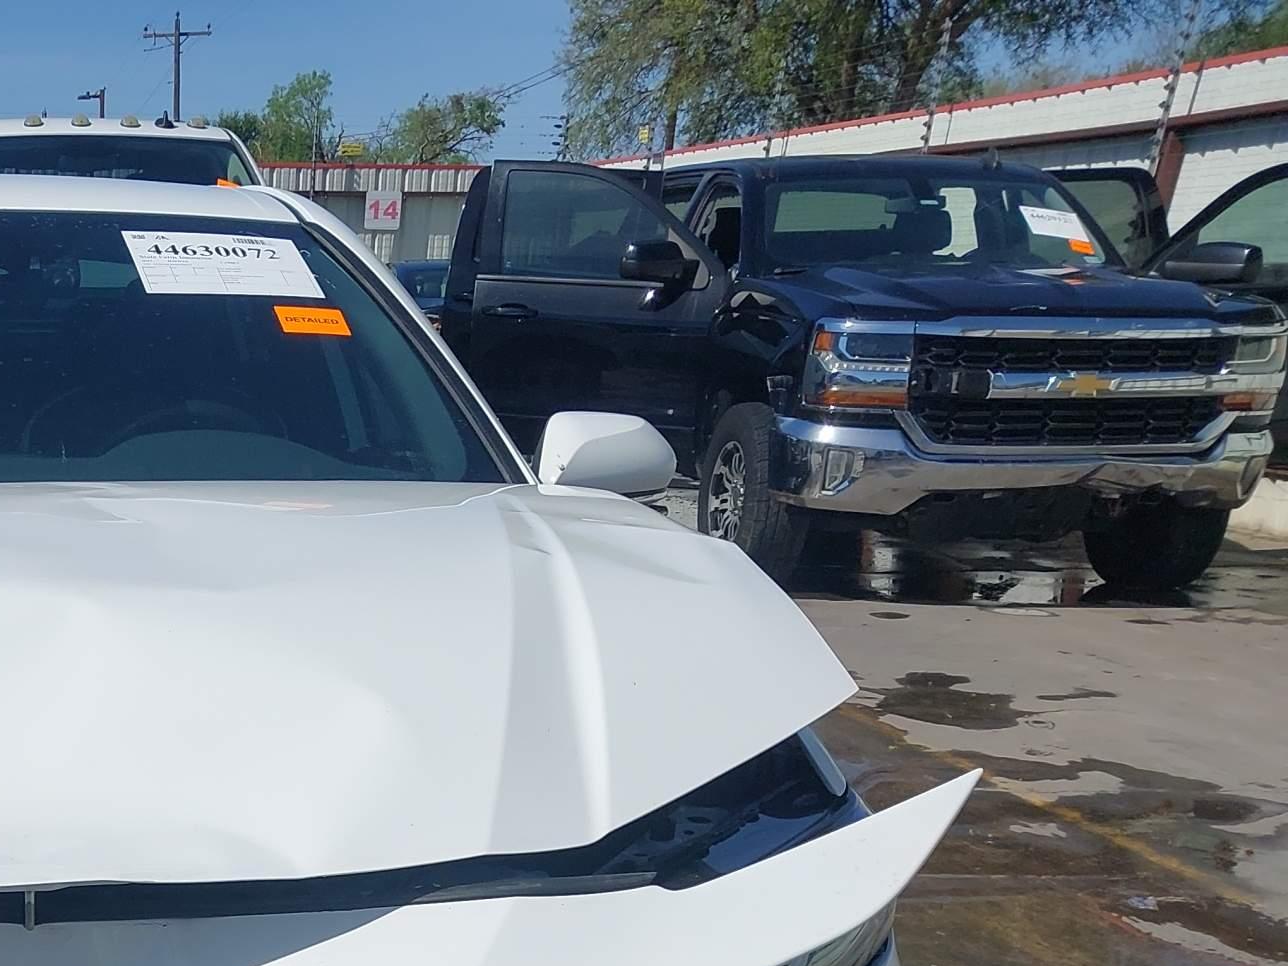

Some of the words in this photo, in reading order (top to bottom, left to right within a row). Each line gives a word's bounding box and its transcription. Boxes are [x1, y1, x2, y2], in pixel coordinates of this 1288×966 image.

[369, 200, 399, 220] 14
[147, 244, 280, 260] 44630072
[285, 316, 339, 325] DETAILED
